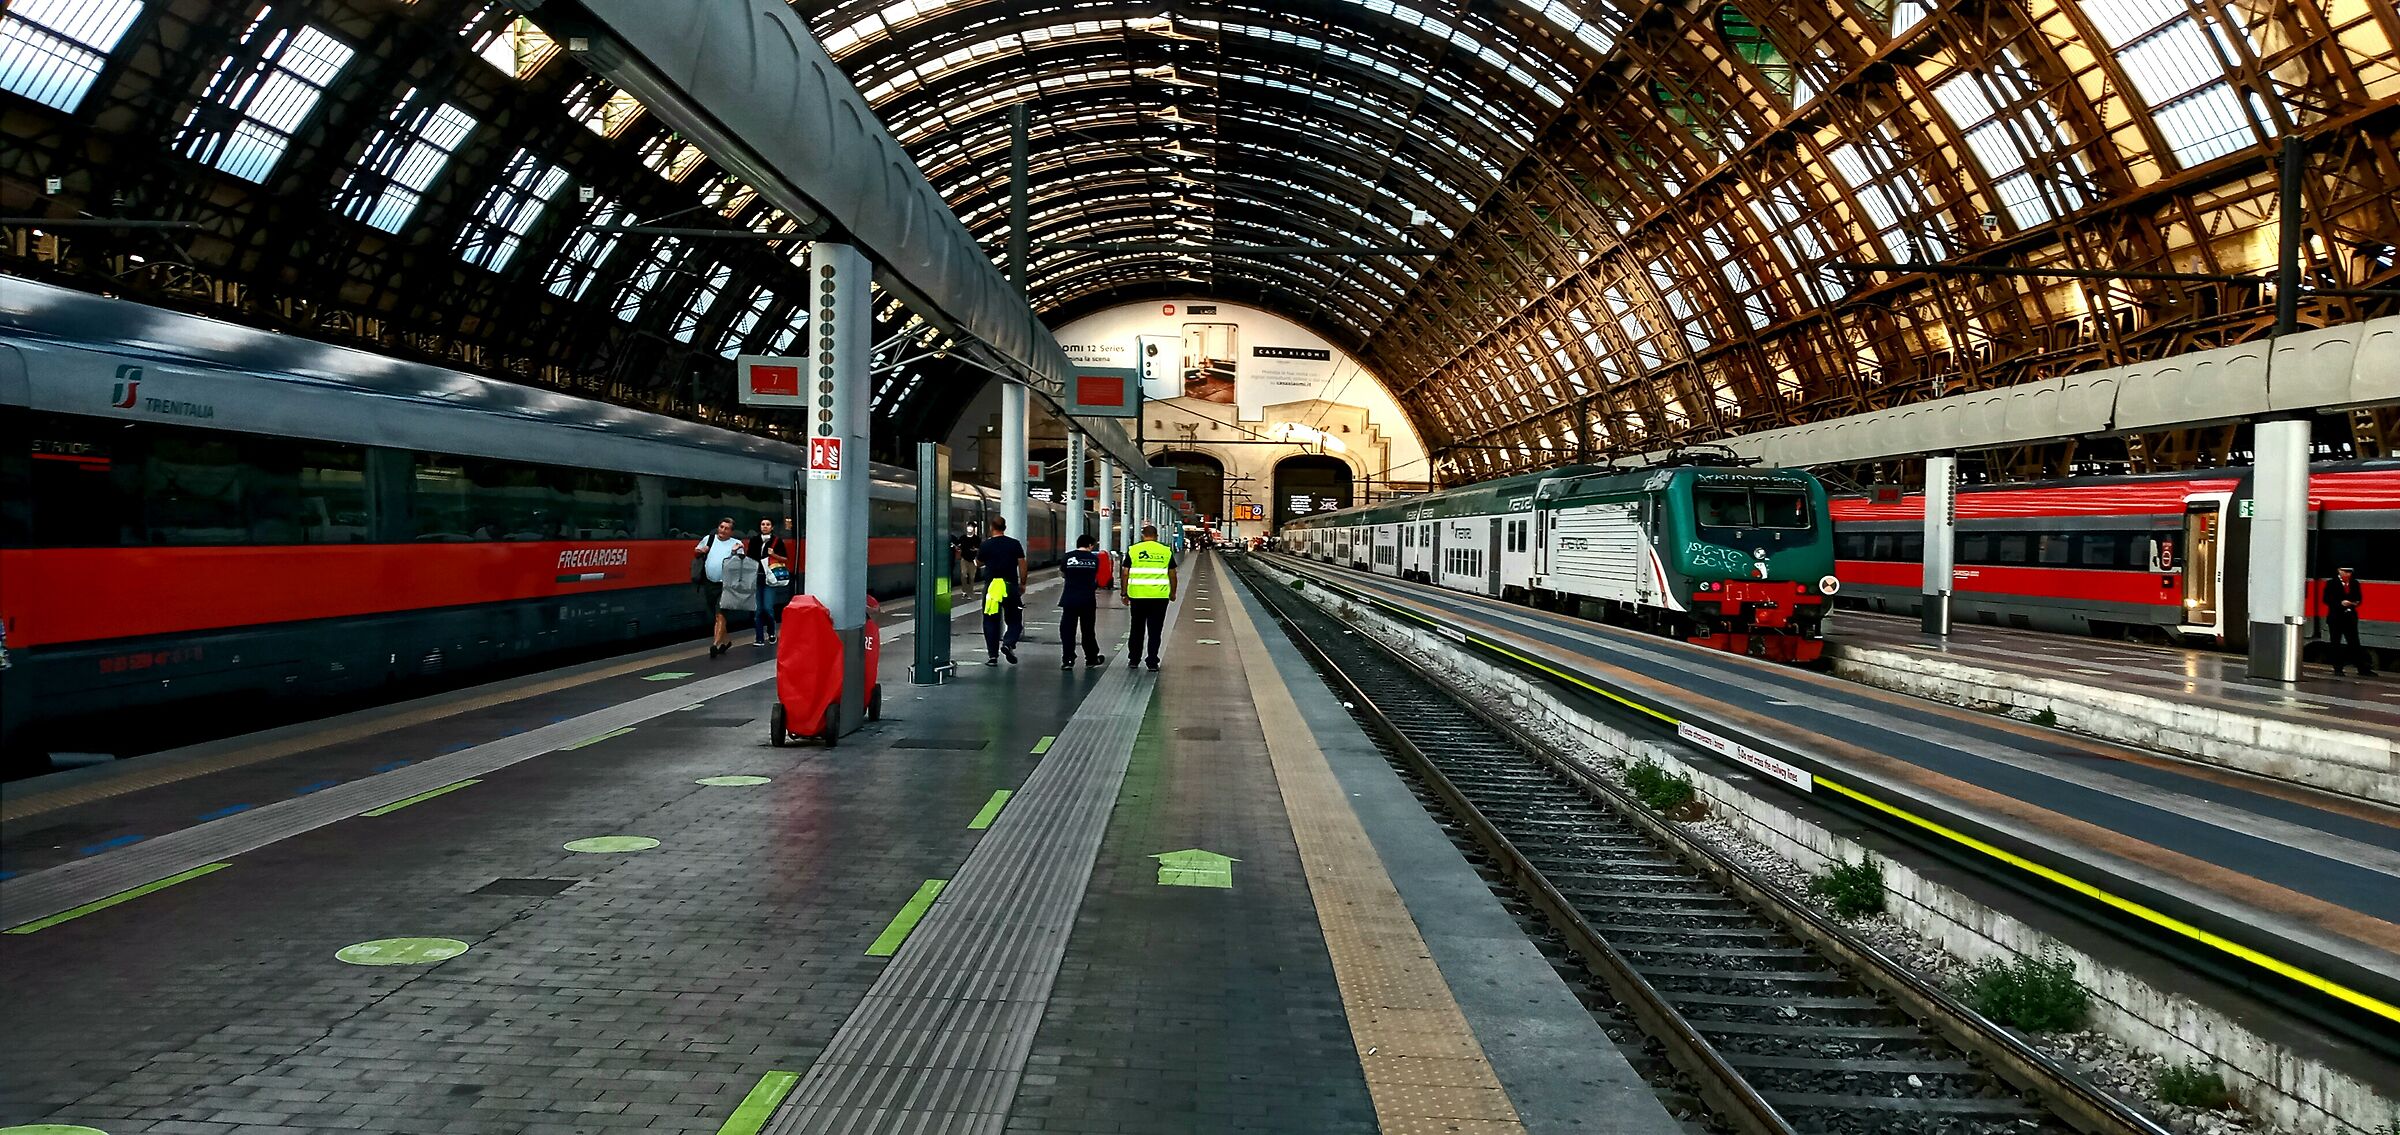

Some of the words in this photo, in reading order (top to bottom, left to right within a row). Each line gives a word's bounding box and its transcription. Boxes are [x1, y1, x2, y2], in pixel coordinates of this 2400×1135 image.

[1087, 344, 1096, 352] 12
[772, 373, 778, 385] 7
[145, 397, 214, 419] TRENITALIA
[557, 548, 628, 569] FRECCIAROSSA
